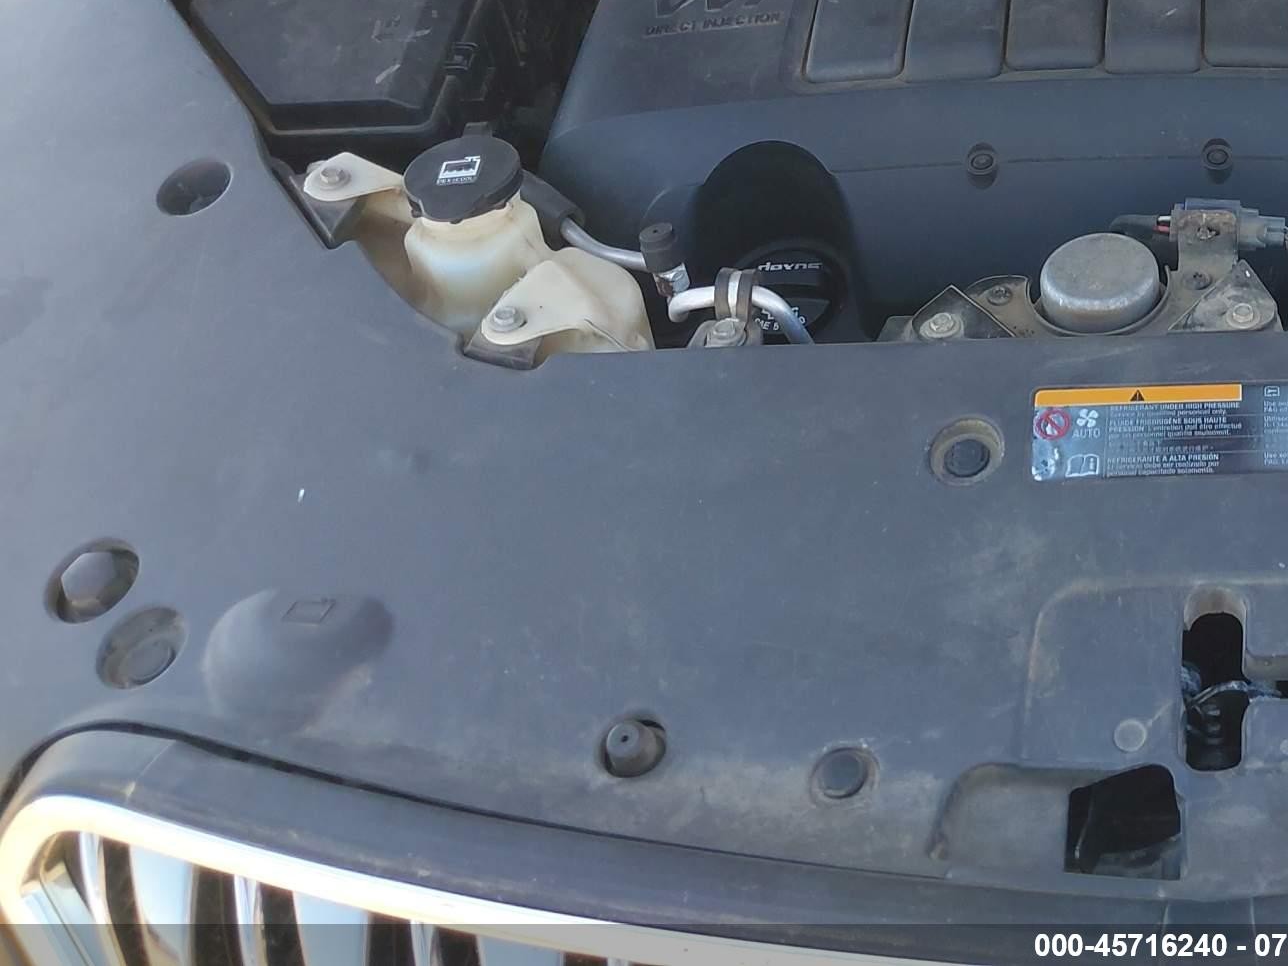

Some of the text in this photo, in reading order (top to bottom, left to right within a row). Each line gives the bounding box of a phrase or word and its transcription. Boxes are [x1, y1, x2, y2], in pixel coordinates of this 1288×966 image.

[1160, 403, 1184, 411] UNDER
[1185, 402, 1202, 410] HIGH
[1204, 401, 1240, 409] PRESSURE
[1204, 416, 1227, 424] HAUTE
[1073, 428, 1101, 439] AUTO
[1169, 454, 1187, 462] ALTA
